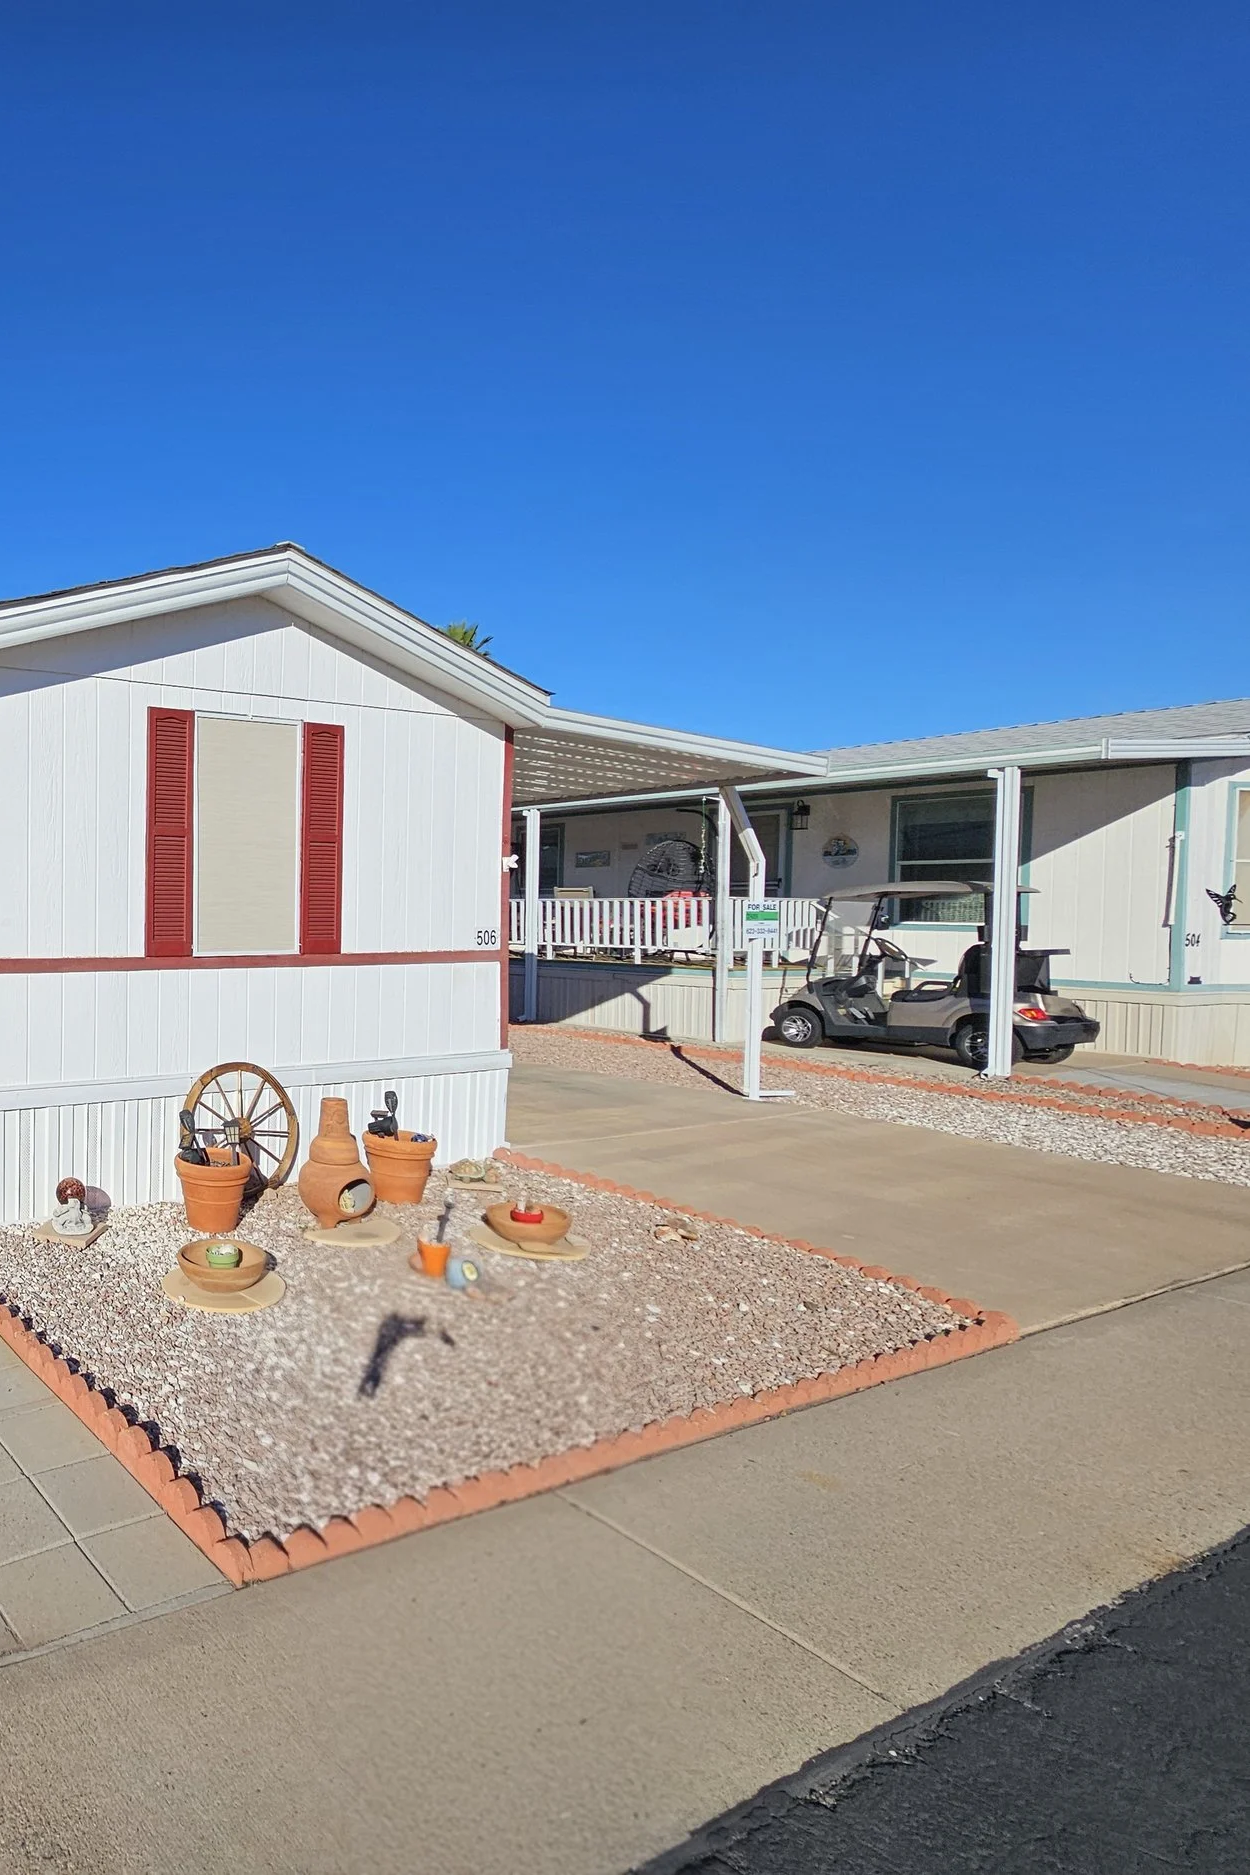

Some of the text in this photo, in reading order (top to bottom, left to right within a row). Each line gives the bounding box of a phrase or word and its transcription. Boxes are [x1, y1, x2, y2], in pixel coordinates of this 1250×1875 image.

[747, 903, 777, 911] FOR SALE
[476, 929, 497, 946] 506
[1184, 933, 1201, 947] 504
